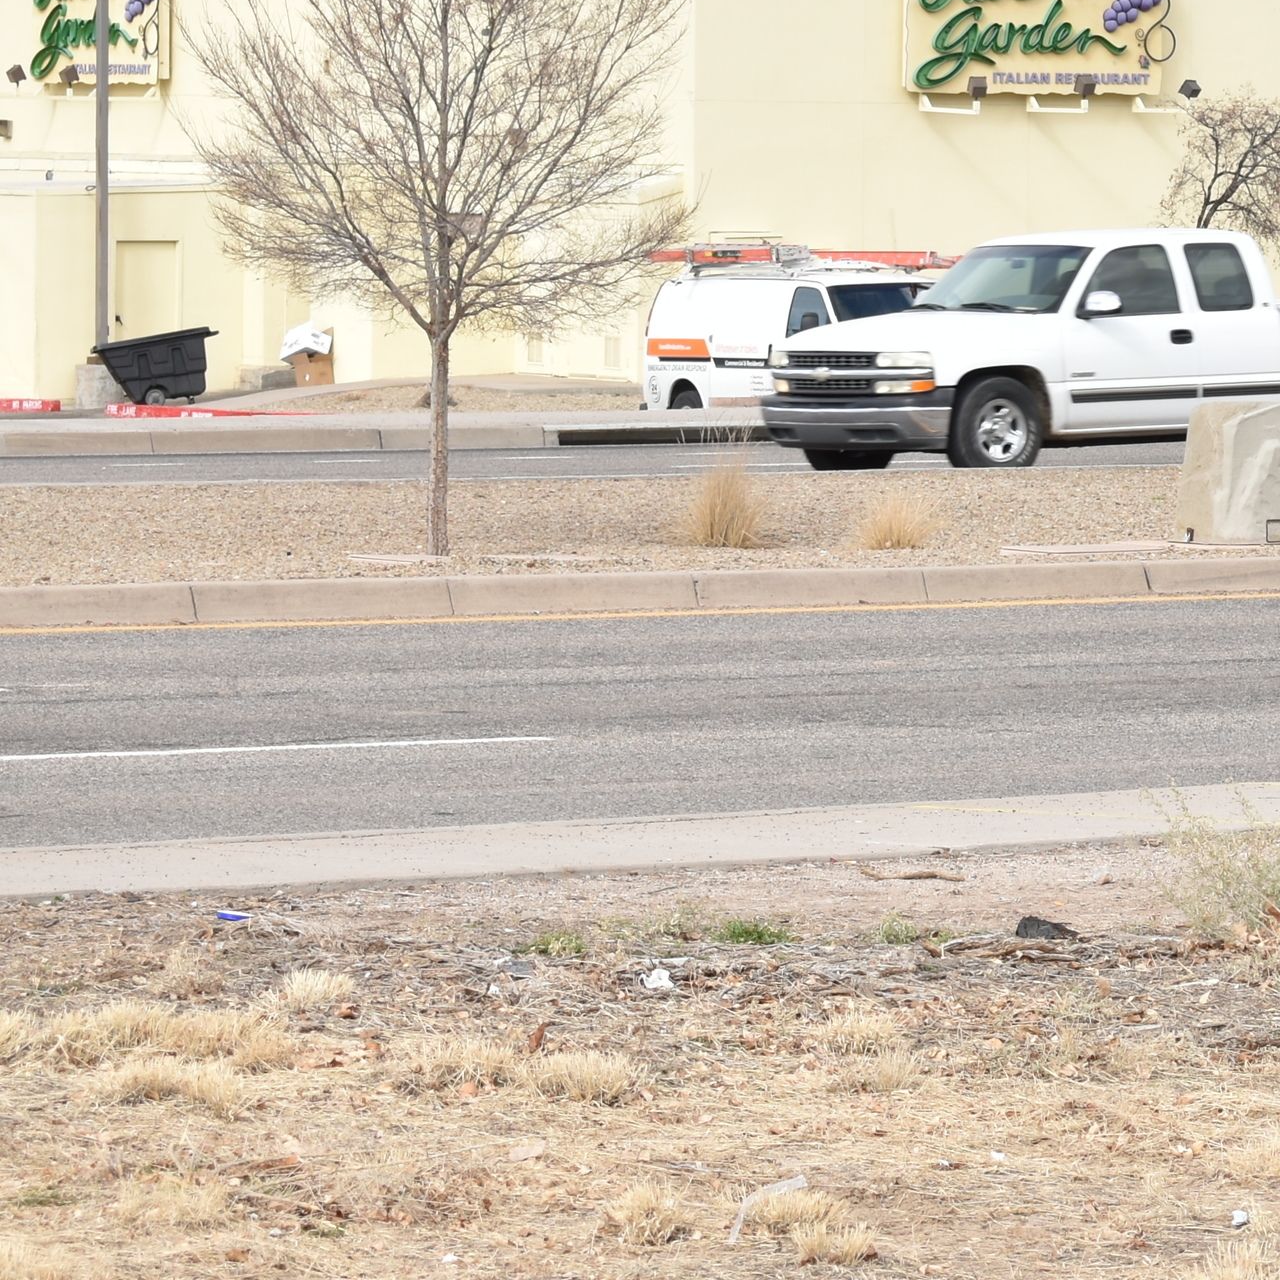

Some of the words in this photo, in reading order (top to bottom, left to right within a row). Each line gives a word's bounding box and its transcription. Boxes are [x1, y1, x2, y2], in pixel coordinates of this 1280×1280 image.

[913, 0, 1128, 89] Garden
[992, 72, 1051, 85] ITALIAN
[1055, 73, 1151, 85] RESAURANT
